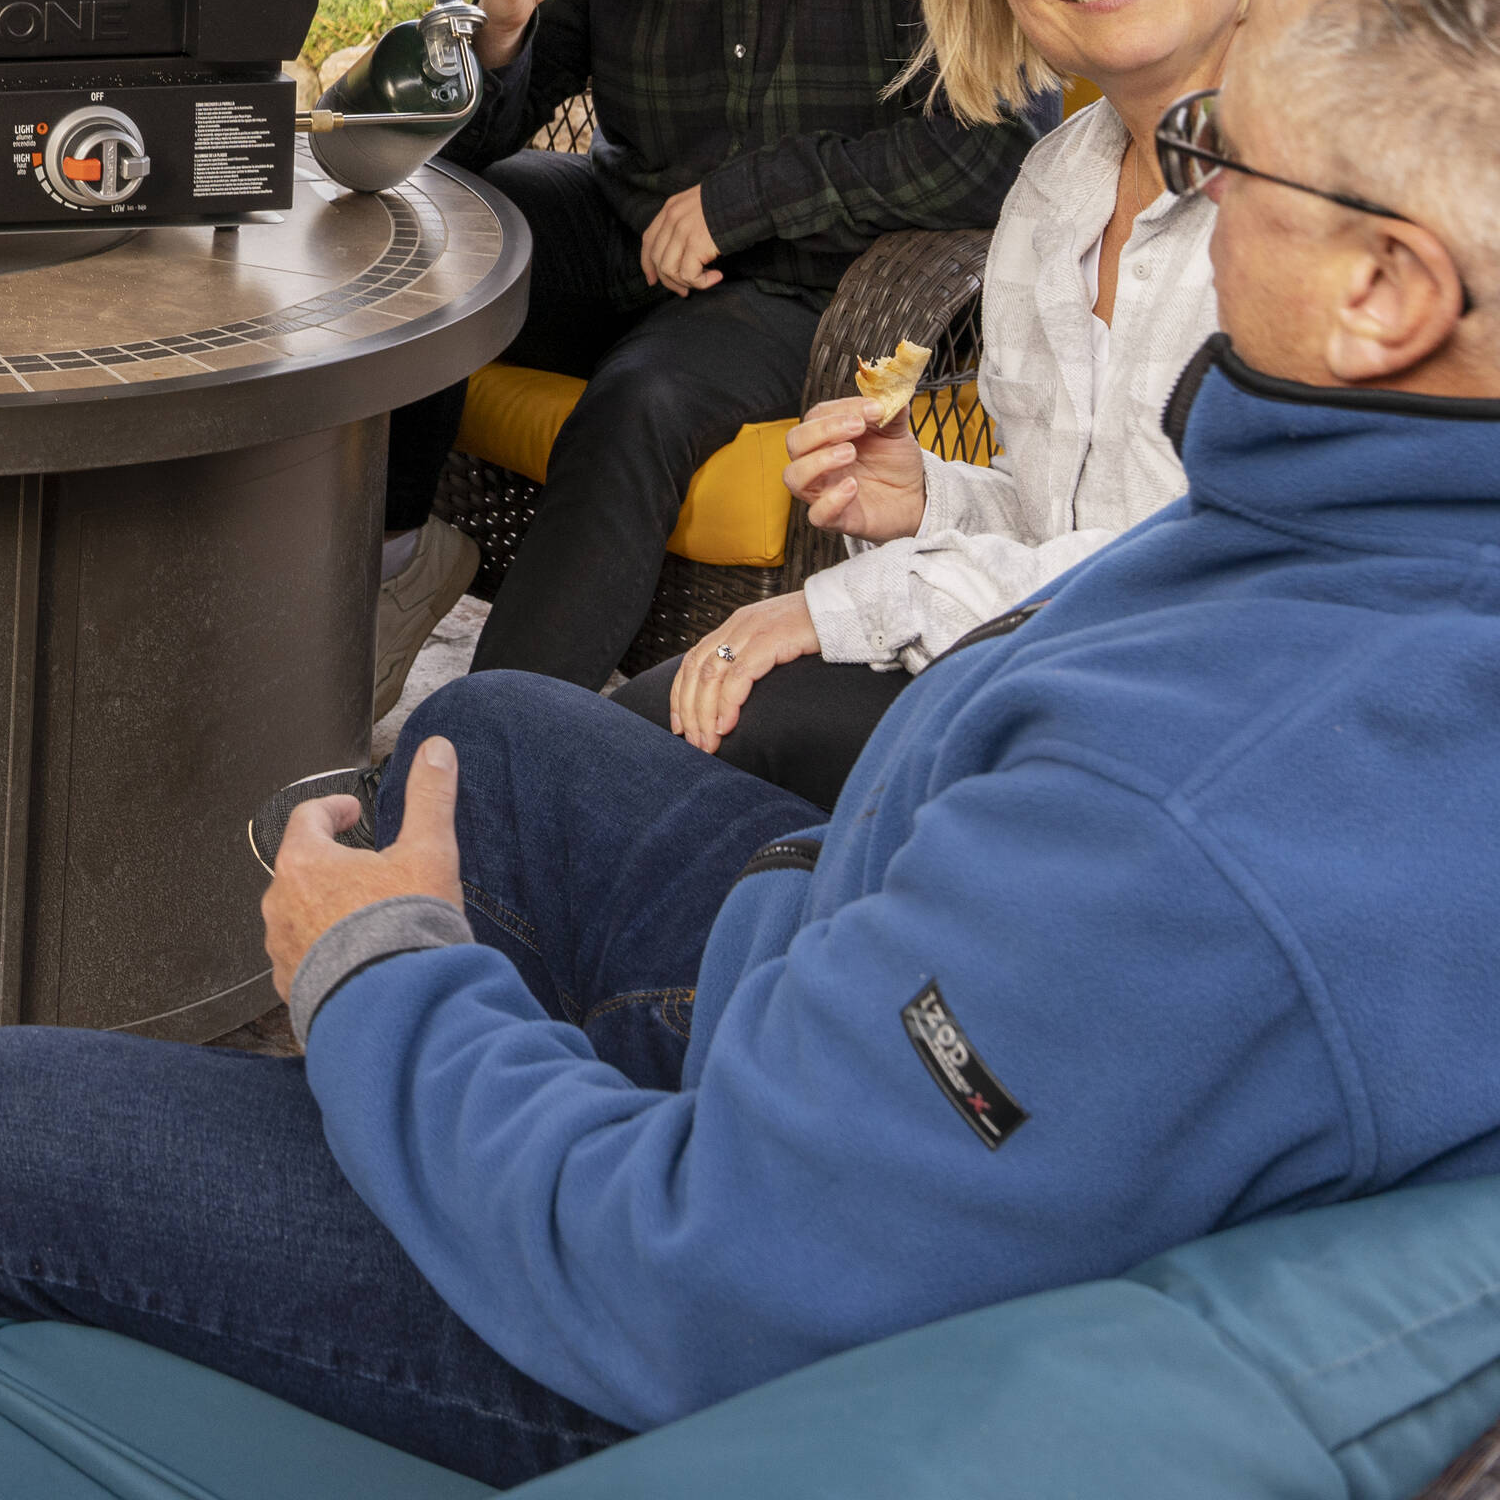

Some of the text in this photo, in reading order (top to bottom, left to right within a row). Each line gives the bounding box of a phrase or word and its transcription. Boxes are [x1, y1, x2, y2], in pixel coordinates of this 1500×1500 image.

[91, 92, 104, 101] OFF
[14, 124, 35, 134] LIGHT
[13, 153, 31, 163] HIGH
[111, 204, 125, 212] LOW
[920, 990, 969, 1068] IZOD
